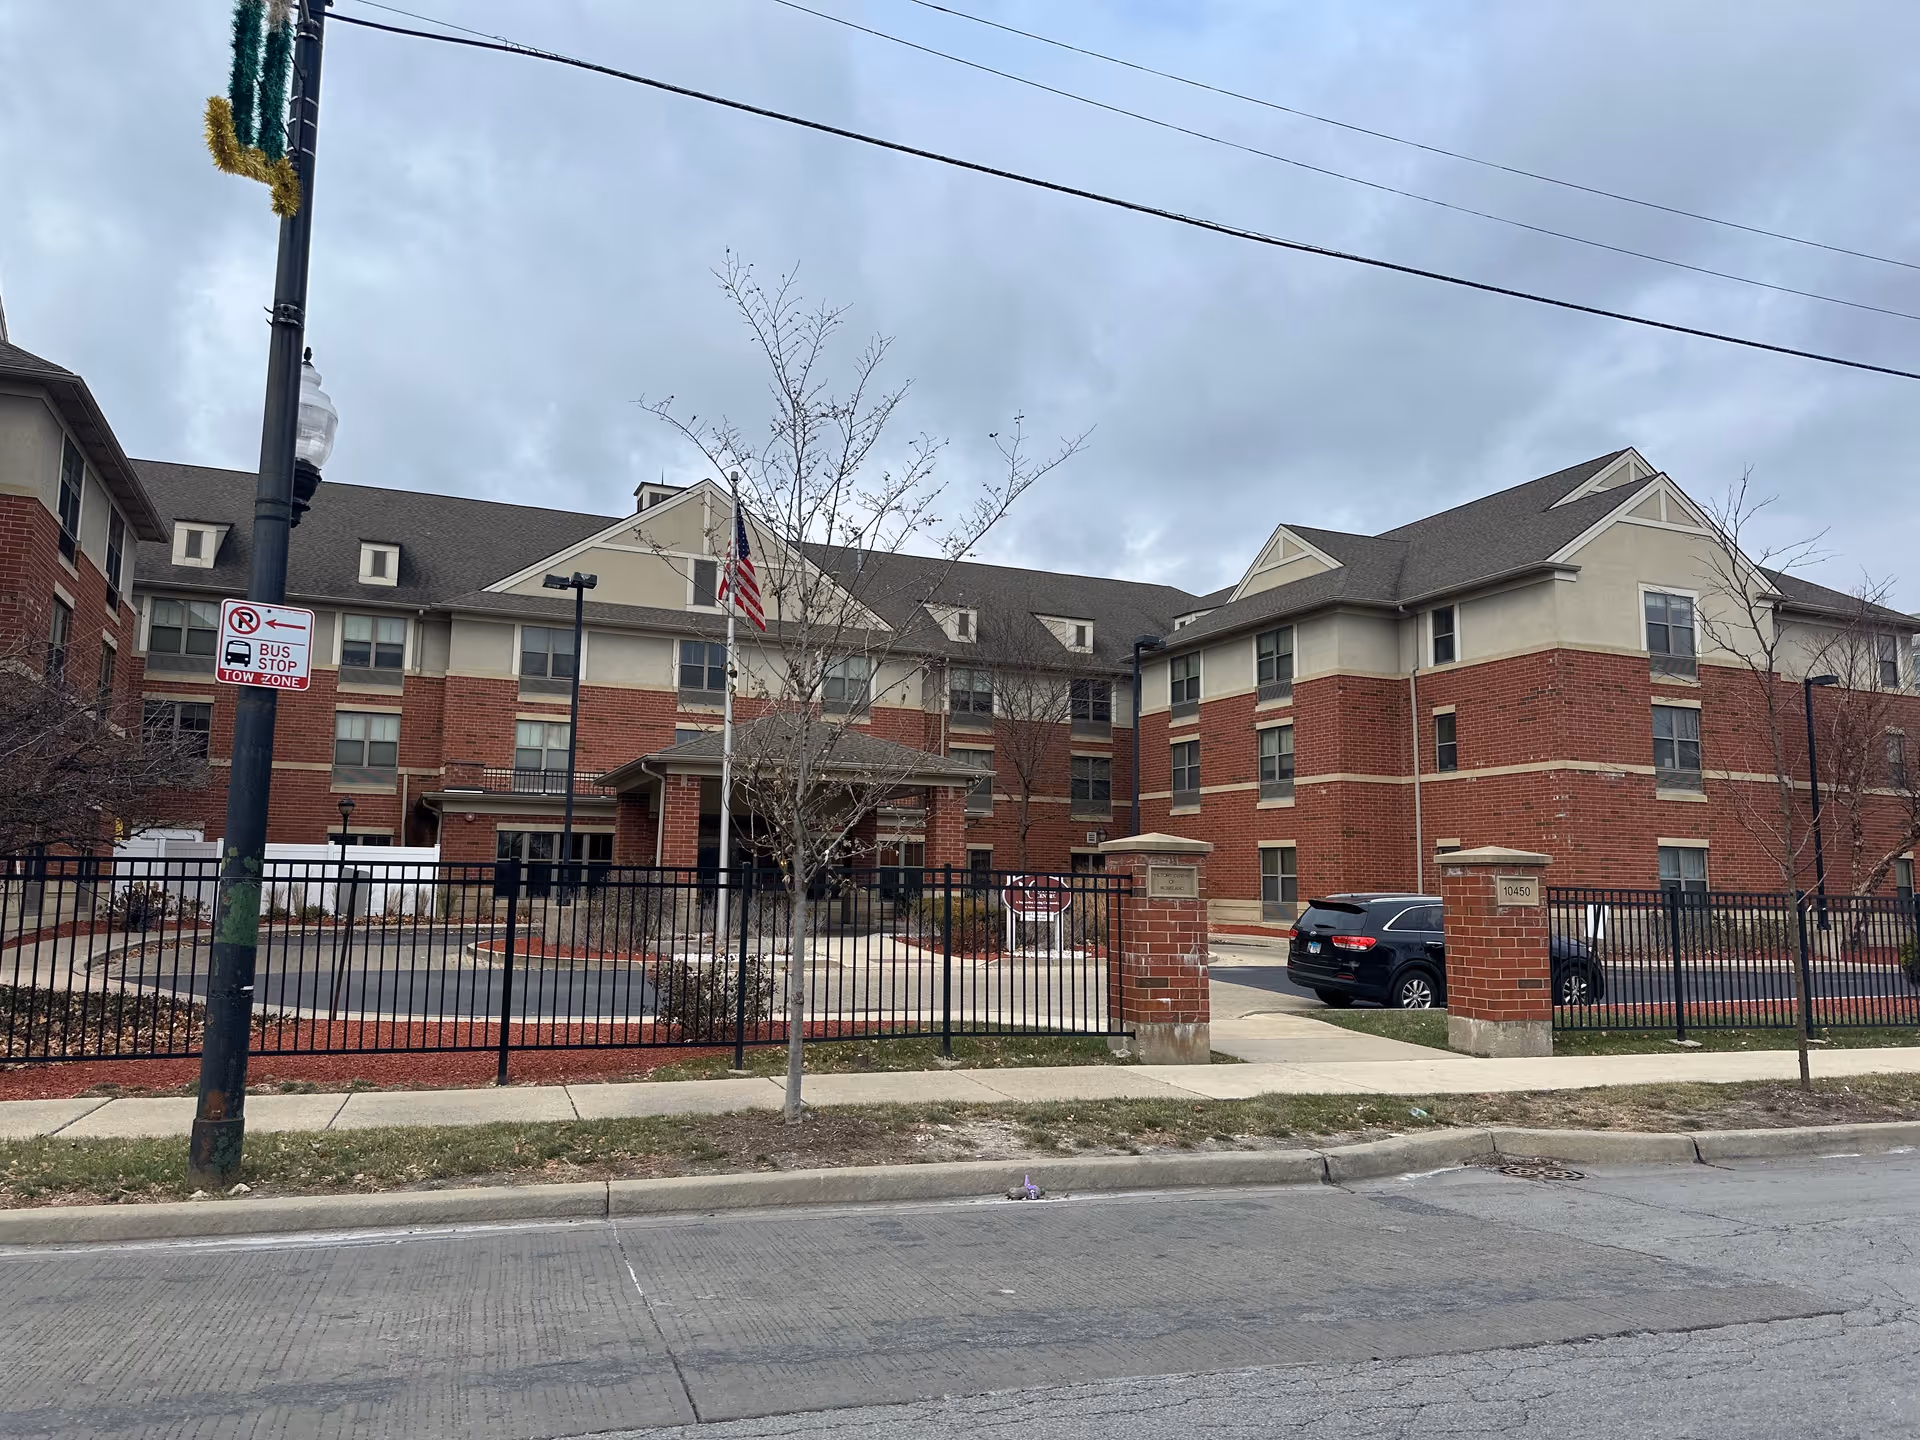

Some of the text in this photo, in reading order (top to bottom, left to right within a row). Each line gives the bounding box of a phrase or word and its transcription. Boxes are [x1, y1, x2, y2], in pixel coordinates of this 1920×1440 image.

[260, 643, 290, 658] BUS
[258, 657, 298, 673] STOP
[223, 669, 300, 687] TOW ZONE
[1503, 886, 1530, 896] 10450
